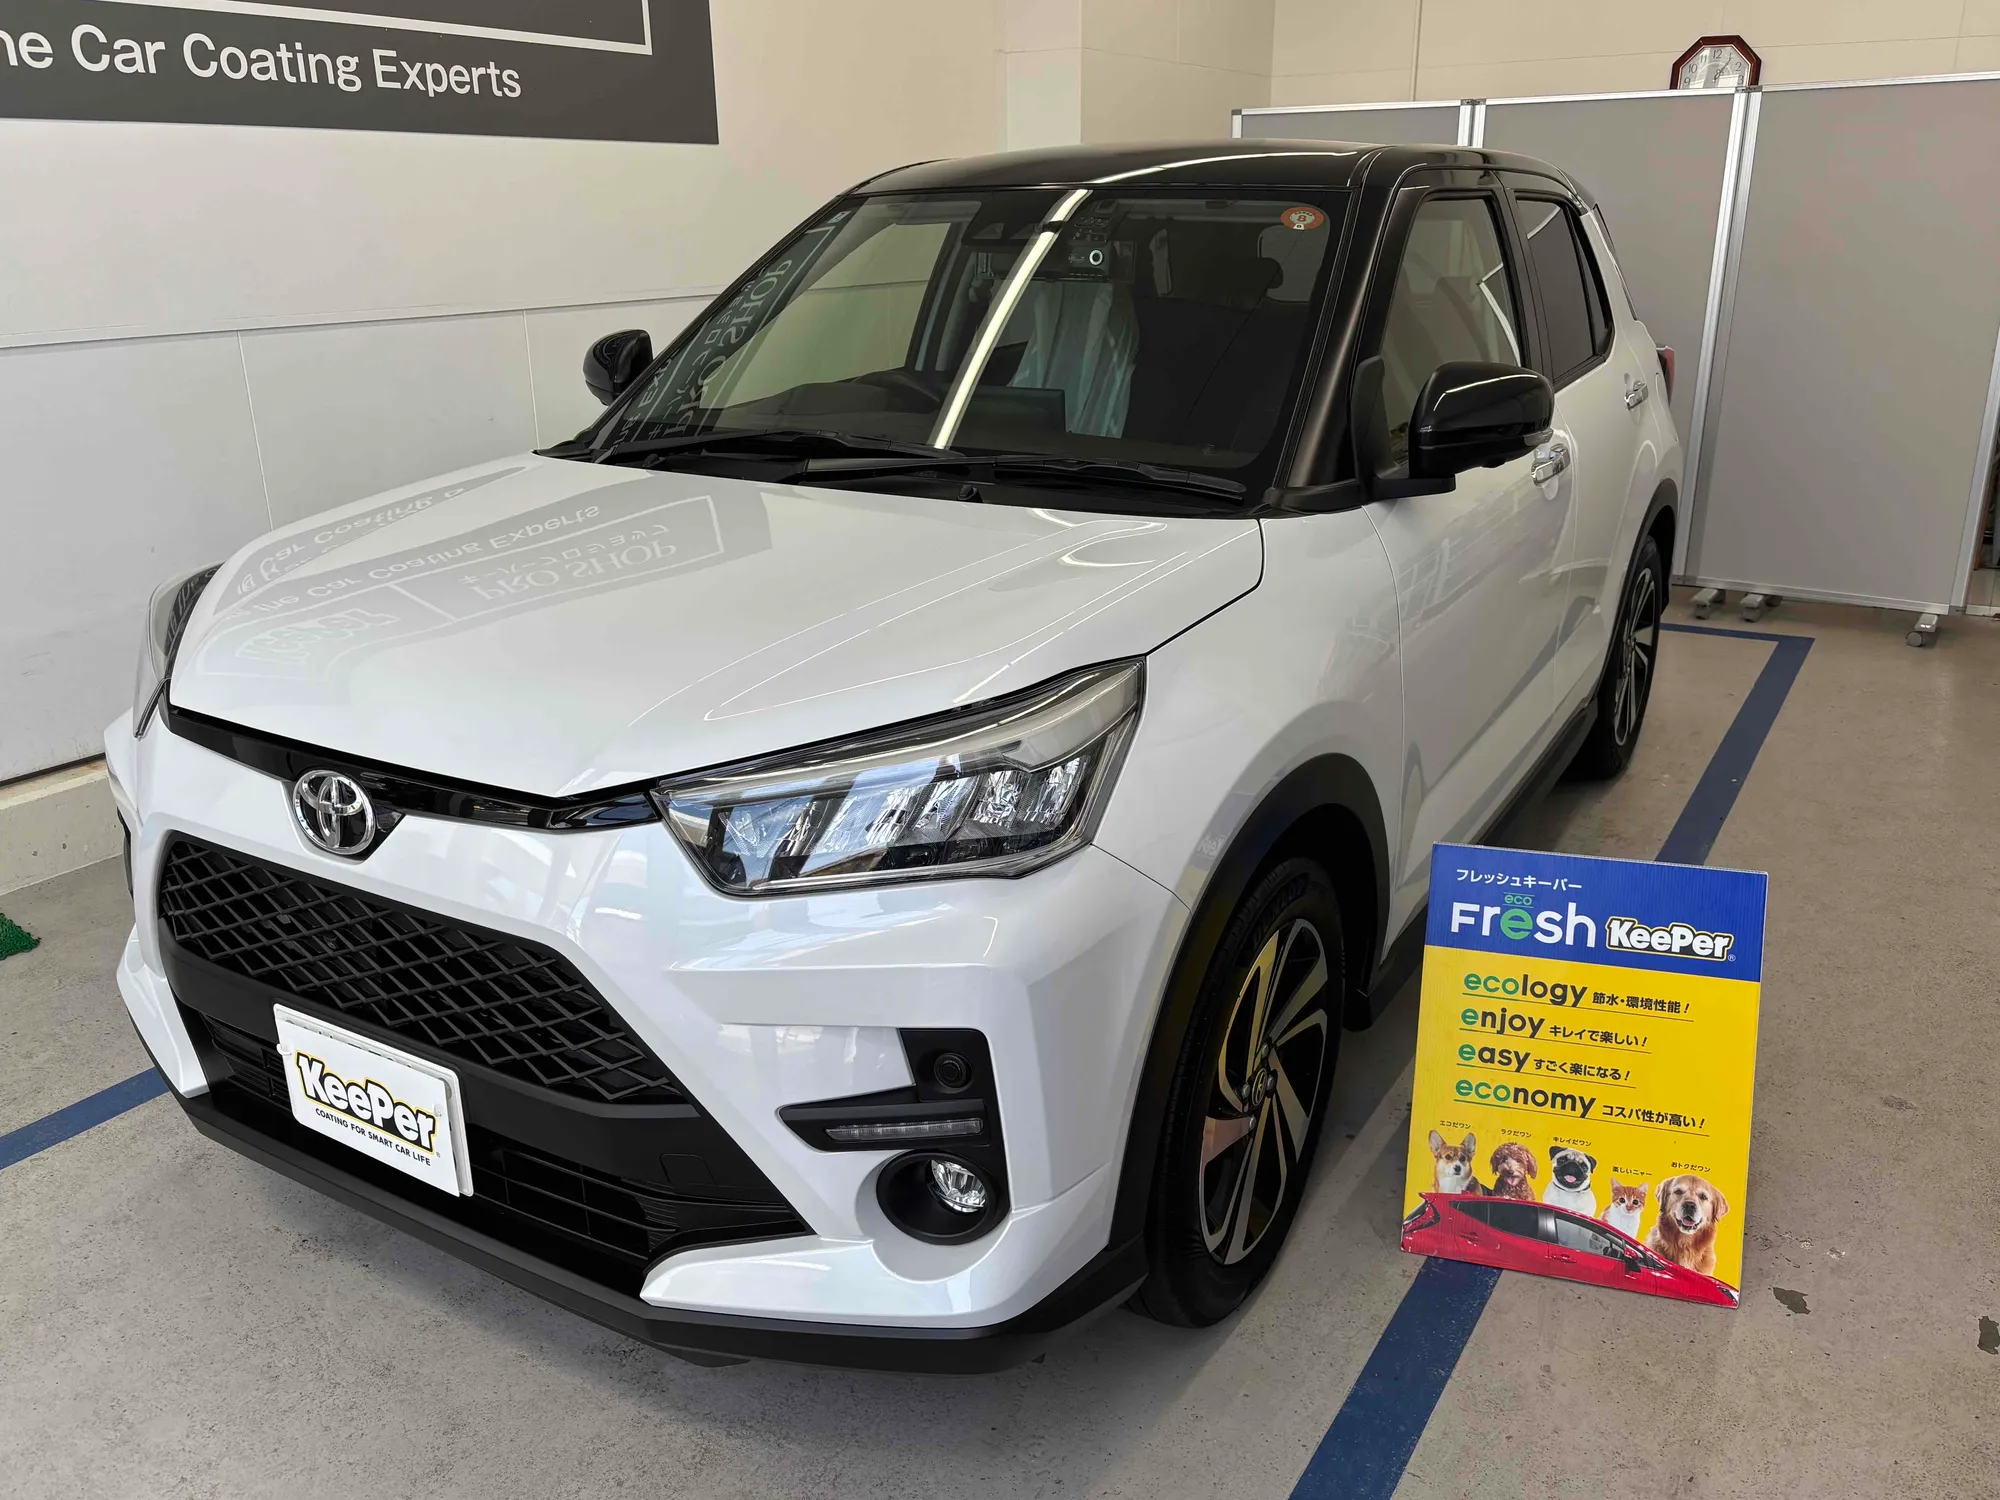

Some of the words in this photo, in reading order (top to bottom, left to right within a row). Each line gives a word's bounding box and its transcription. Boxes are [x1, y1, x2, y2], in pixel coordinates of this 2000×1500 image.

[1700, 55, 1708, 63] 11
[1712, 49, 1723, 59] 12
[71, 24, 166, 74] Car
[183, 32, 362, 92] Coating
[372, 48, 522, 98] Experts
[1735, 62, 1742, 72] 2
[1688, 64, 1698, 74] 10
[1684, 77, 1691, 88] 9
[1738, 75, 1744, 85] 3
[1455, 868, 1583, 891] フレッシュキーパー
[1504, 894, 1532, 906] eco
[1450, 901, 1596, 948] Fresh
[1608, 917, 1733, 960] KeePer
[1463, 973, 1588, 1008] ecology
[1460, 1008, 1545, 1039] enjoy
[1458, 1043, 1531, 1073] easy
[297, 1052, 436, 1153] KeePer
[1454, 1078, 1597, 1118] economy
[1439, 1119, 1471, 1130] エコだワン
[315, 1108, 348, 1128] COATING
[350, 1123, 366, 1137] FOR
[368, 1131, 393, 1149] SMART
[395, 1143, 411, 1157] CAR
[412, 1151, 431, 1166] LIFE
[1500, 1128, 1532, 1138] ラクだワン
[1552, 1136, 1592, 1147] キレイだワン
[1612, 1165, 1653, 1176] 楽しいニャー
[1670, 1161, 1711, 1173] おトクだワン
